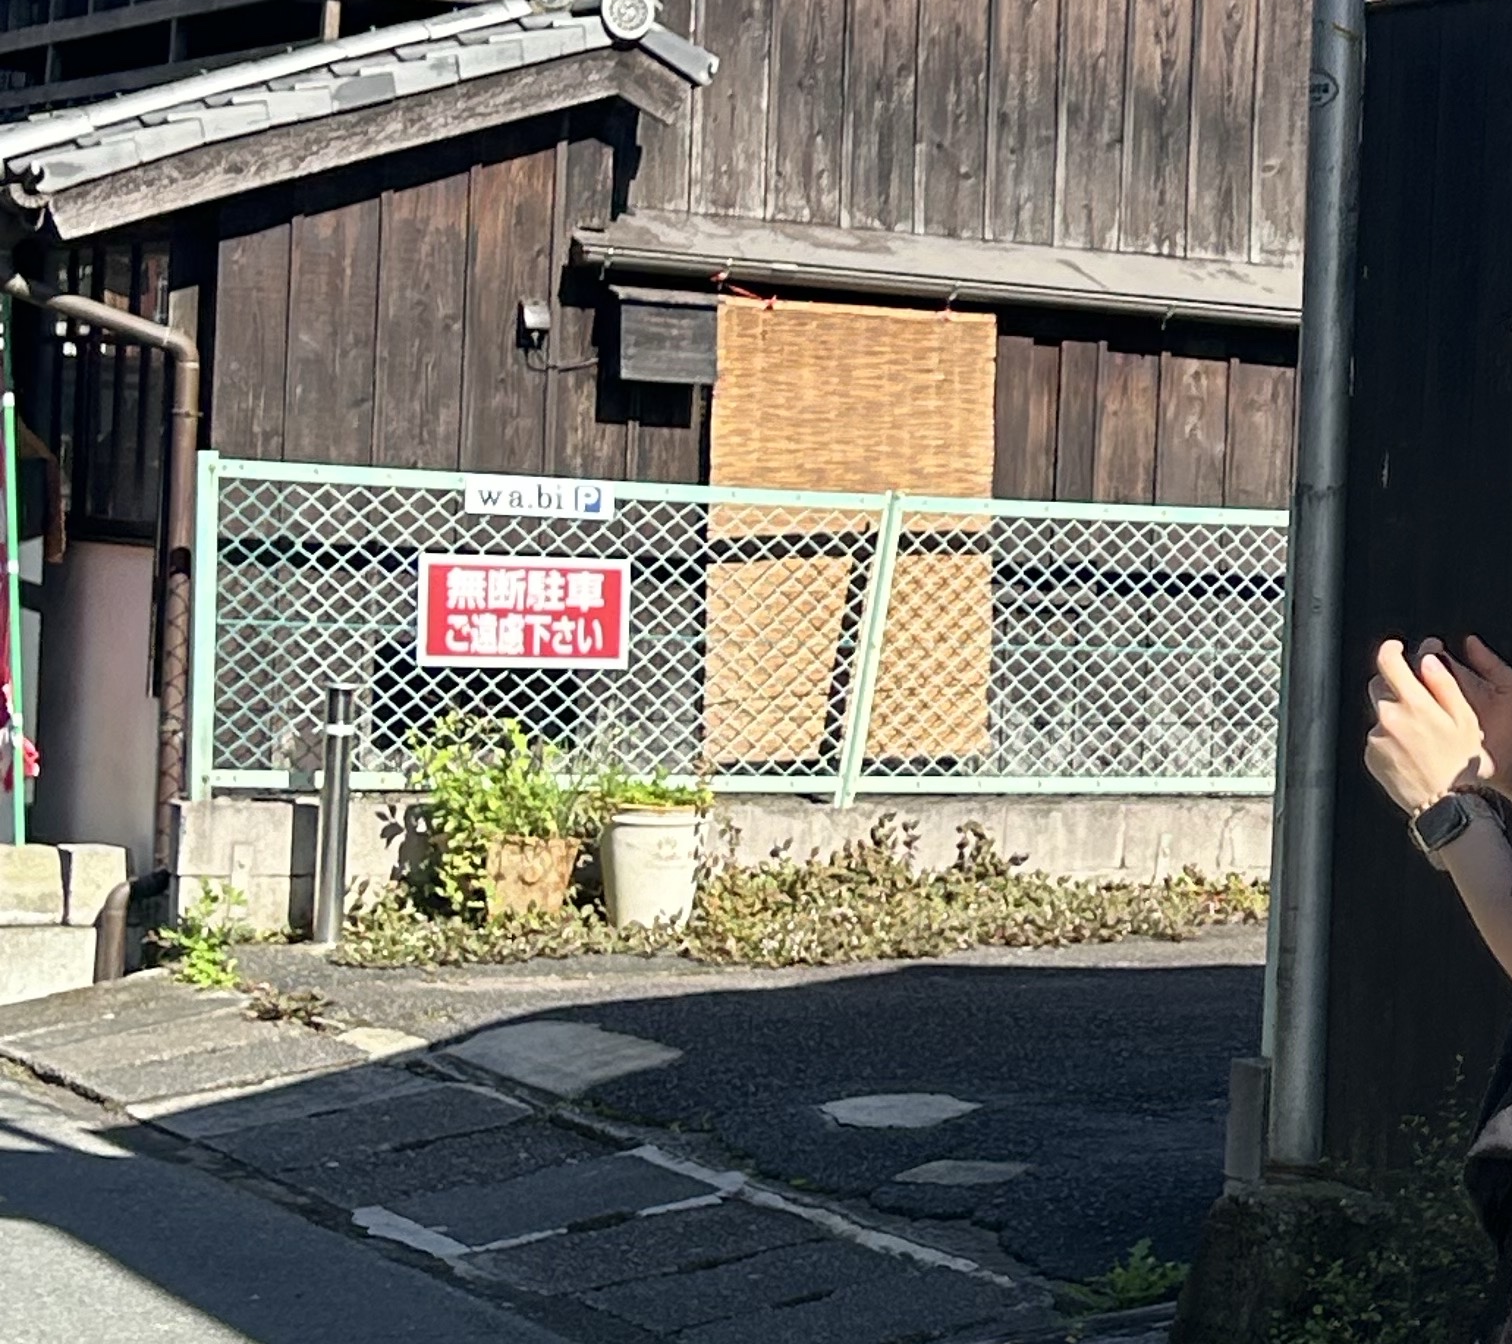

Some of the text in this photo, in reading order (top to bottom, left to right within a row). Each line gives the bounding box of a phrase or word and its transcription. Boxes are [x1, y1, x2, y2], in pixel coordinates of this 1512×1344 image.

[446, 567, 605, 613] 無断駐車
[445, 612, 604, 656] ご遠慮下さい
